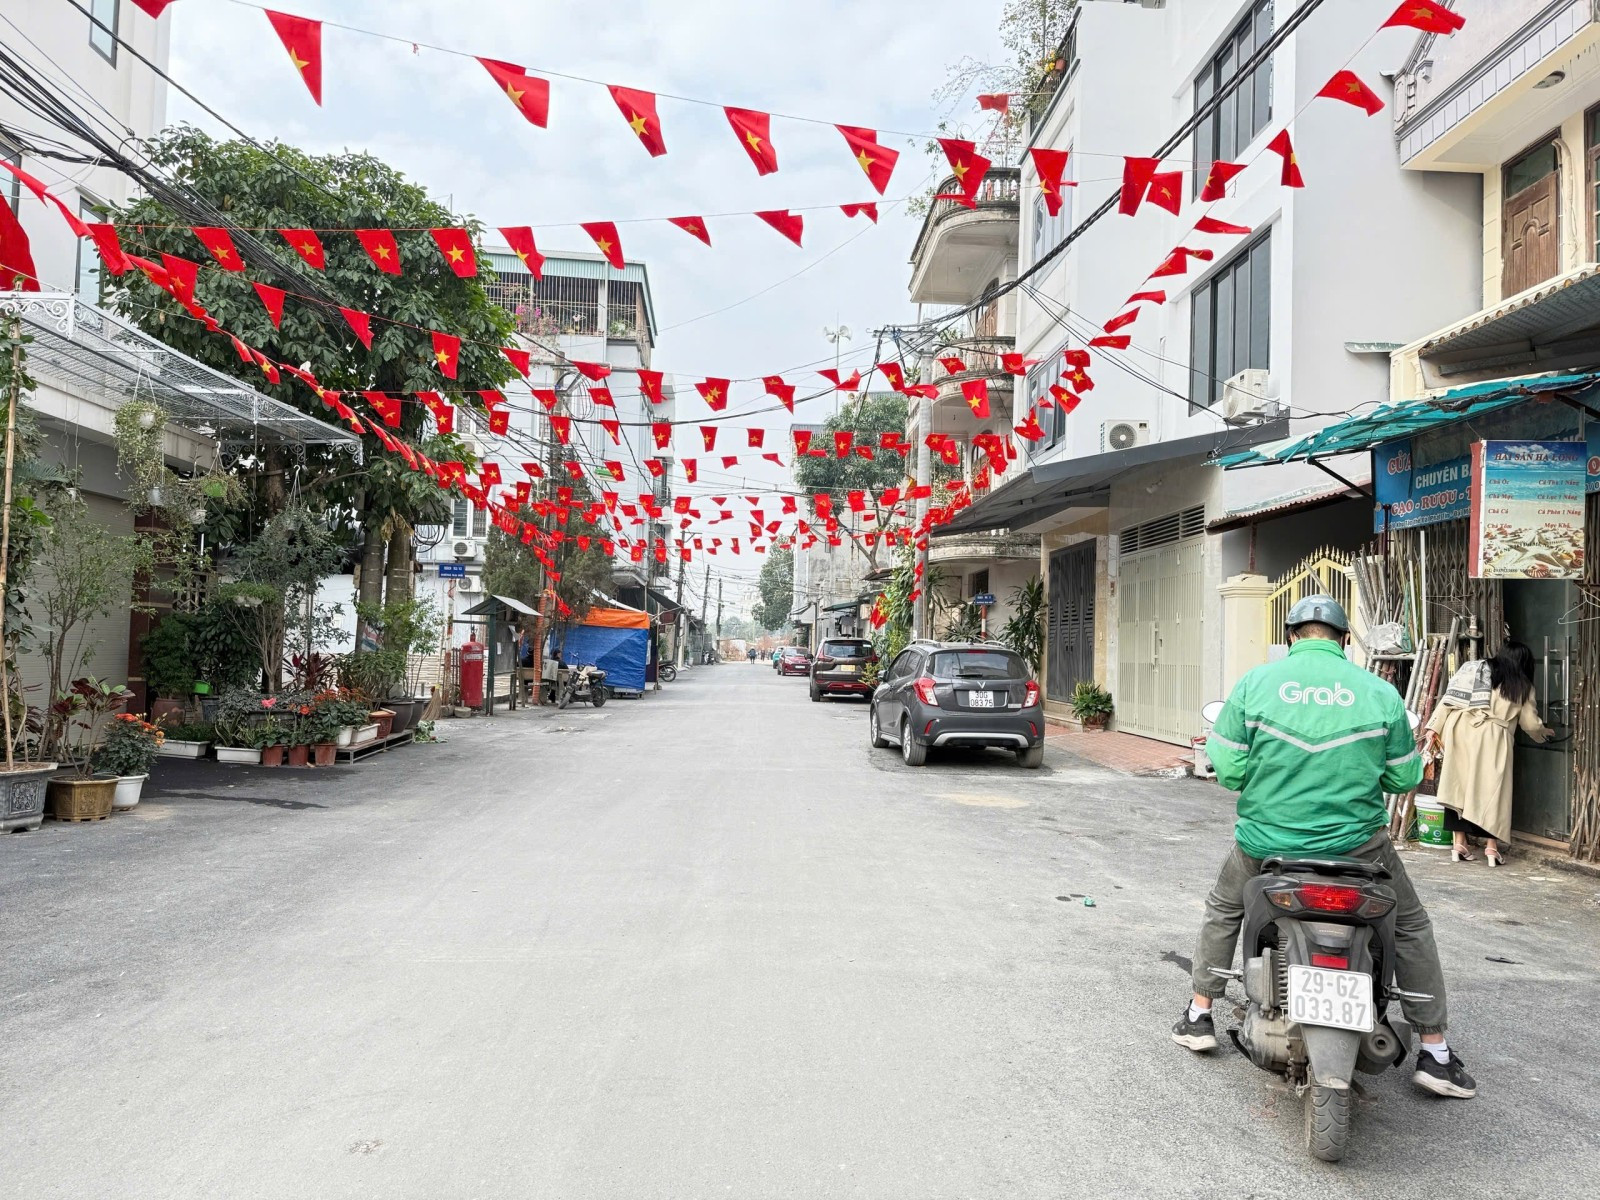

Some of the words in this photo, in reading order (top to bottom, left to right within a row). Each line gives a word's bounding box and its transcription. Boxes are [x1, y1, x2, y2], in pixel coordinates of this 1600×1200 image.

[1415, 466, 1458, 489] CHUYÊN
[1391, 499, 1414, 517] GẠO
[1421, 489, 1458, 510] RƯỢU
[1279, 681, 1355, 707] Grab
[1294, 994, 1367, 1027] 033.87
